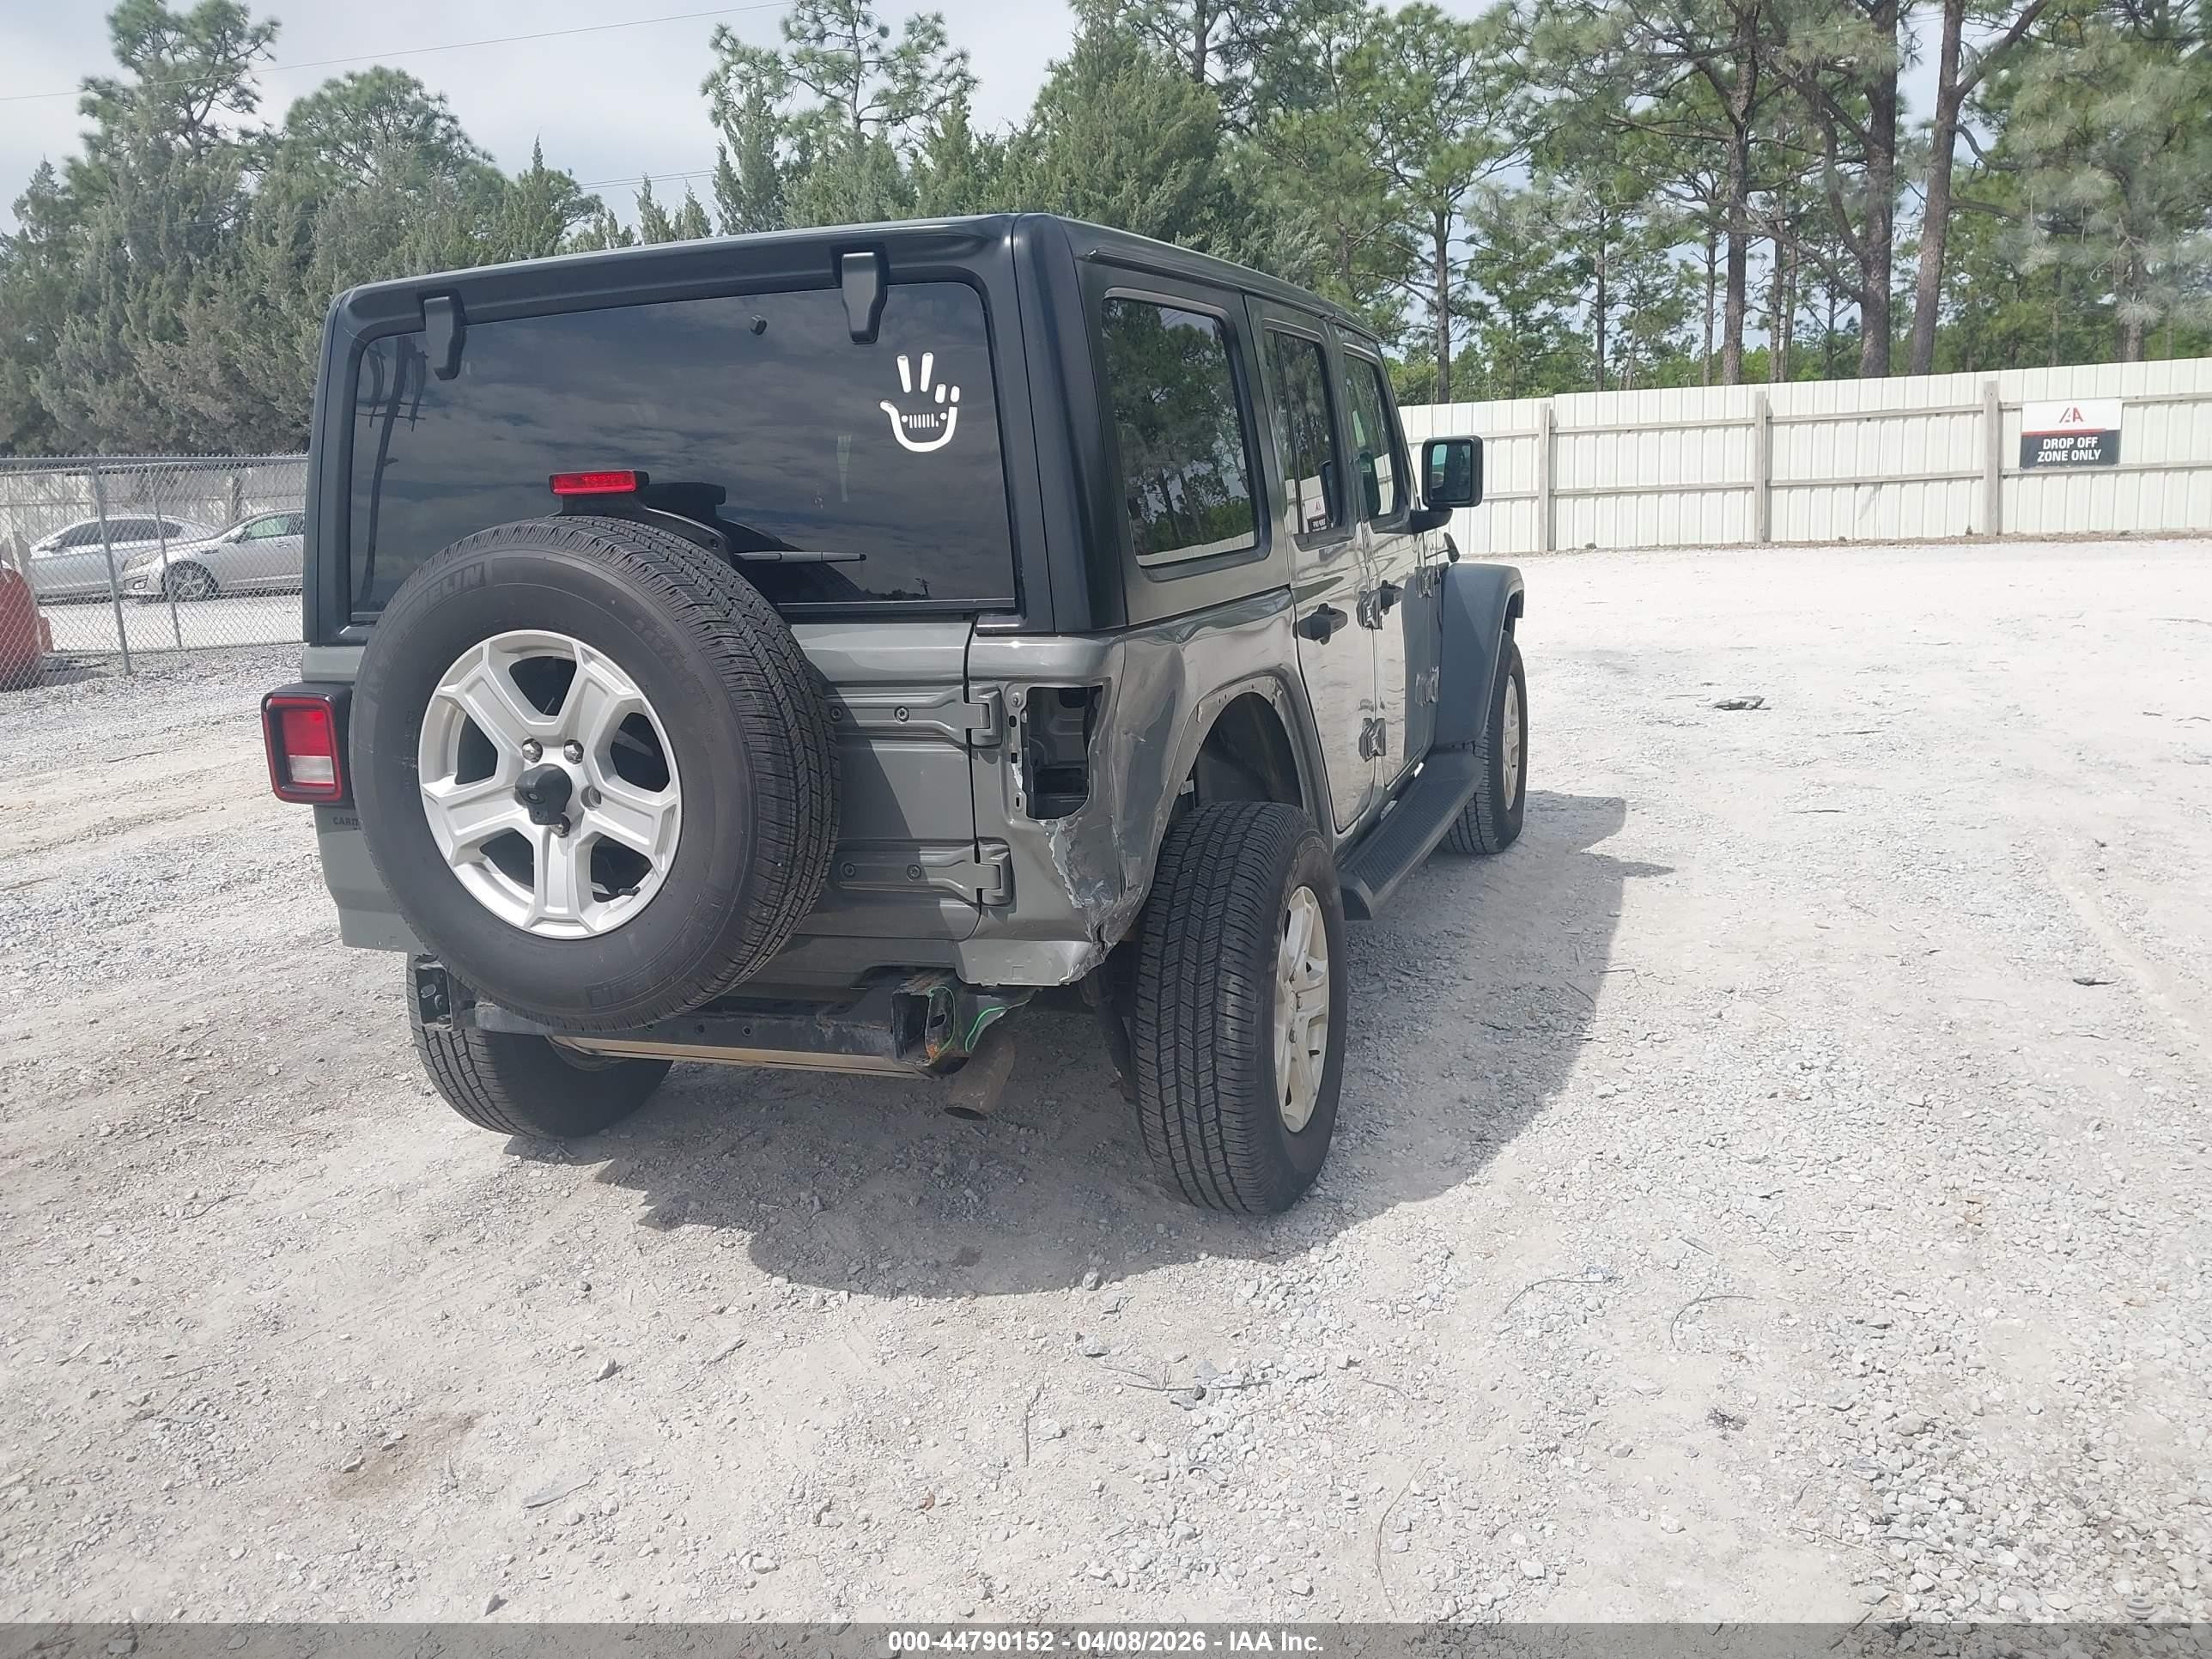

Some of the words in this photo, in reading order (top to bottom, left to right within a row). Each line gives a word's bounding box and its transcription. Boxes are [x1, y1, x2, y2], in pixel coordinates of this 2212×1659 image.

[2043, 438, 2074, 450] DROP
[2077, 436, 2099, 448] OFF
[2037, 451, 2069, 462] ZONE
[2071, 449, 2102, 461] ONLY
